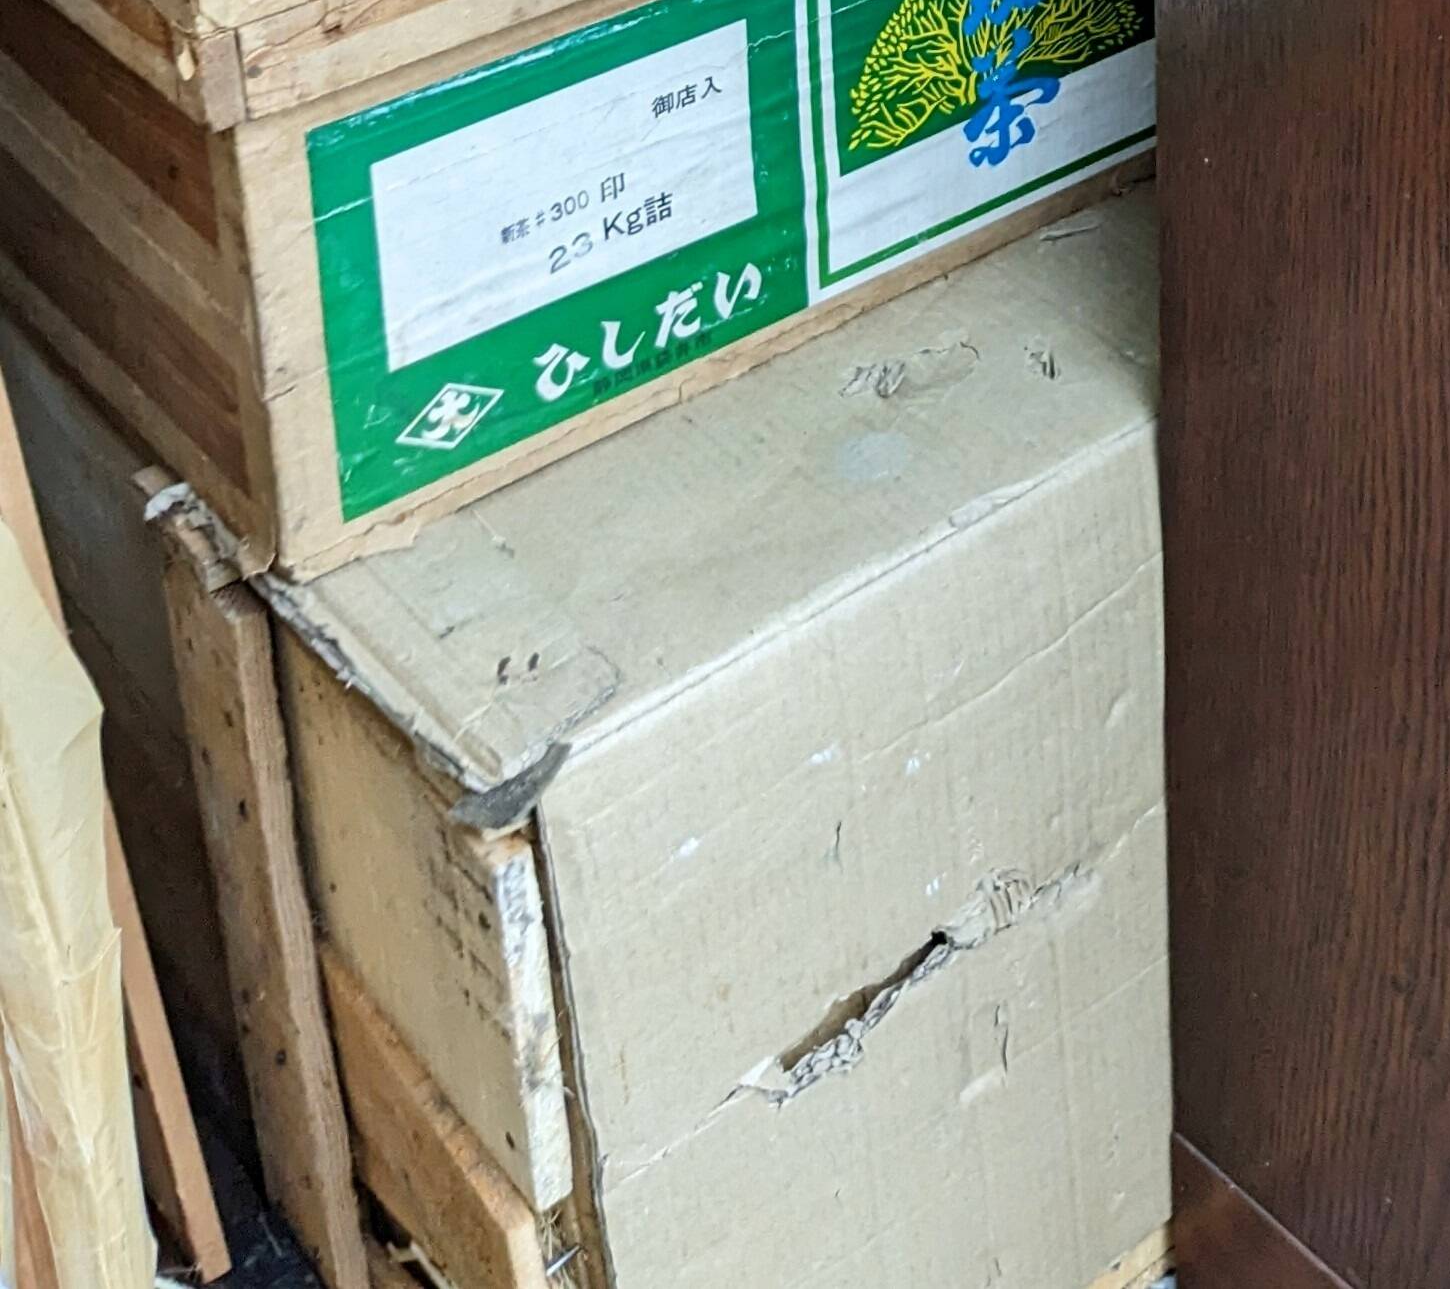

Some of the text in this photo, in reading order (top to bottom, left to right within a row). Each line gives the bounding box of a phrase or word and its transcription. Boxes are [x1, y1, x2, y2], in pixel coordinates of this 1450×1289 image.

[651, 75, 723, 119] 御店入
[532, 262, 763, 403] ひしだい
